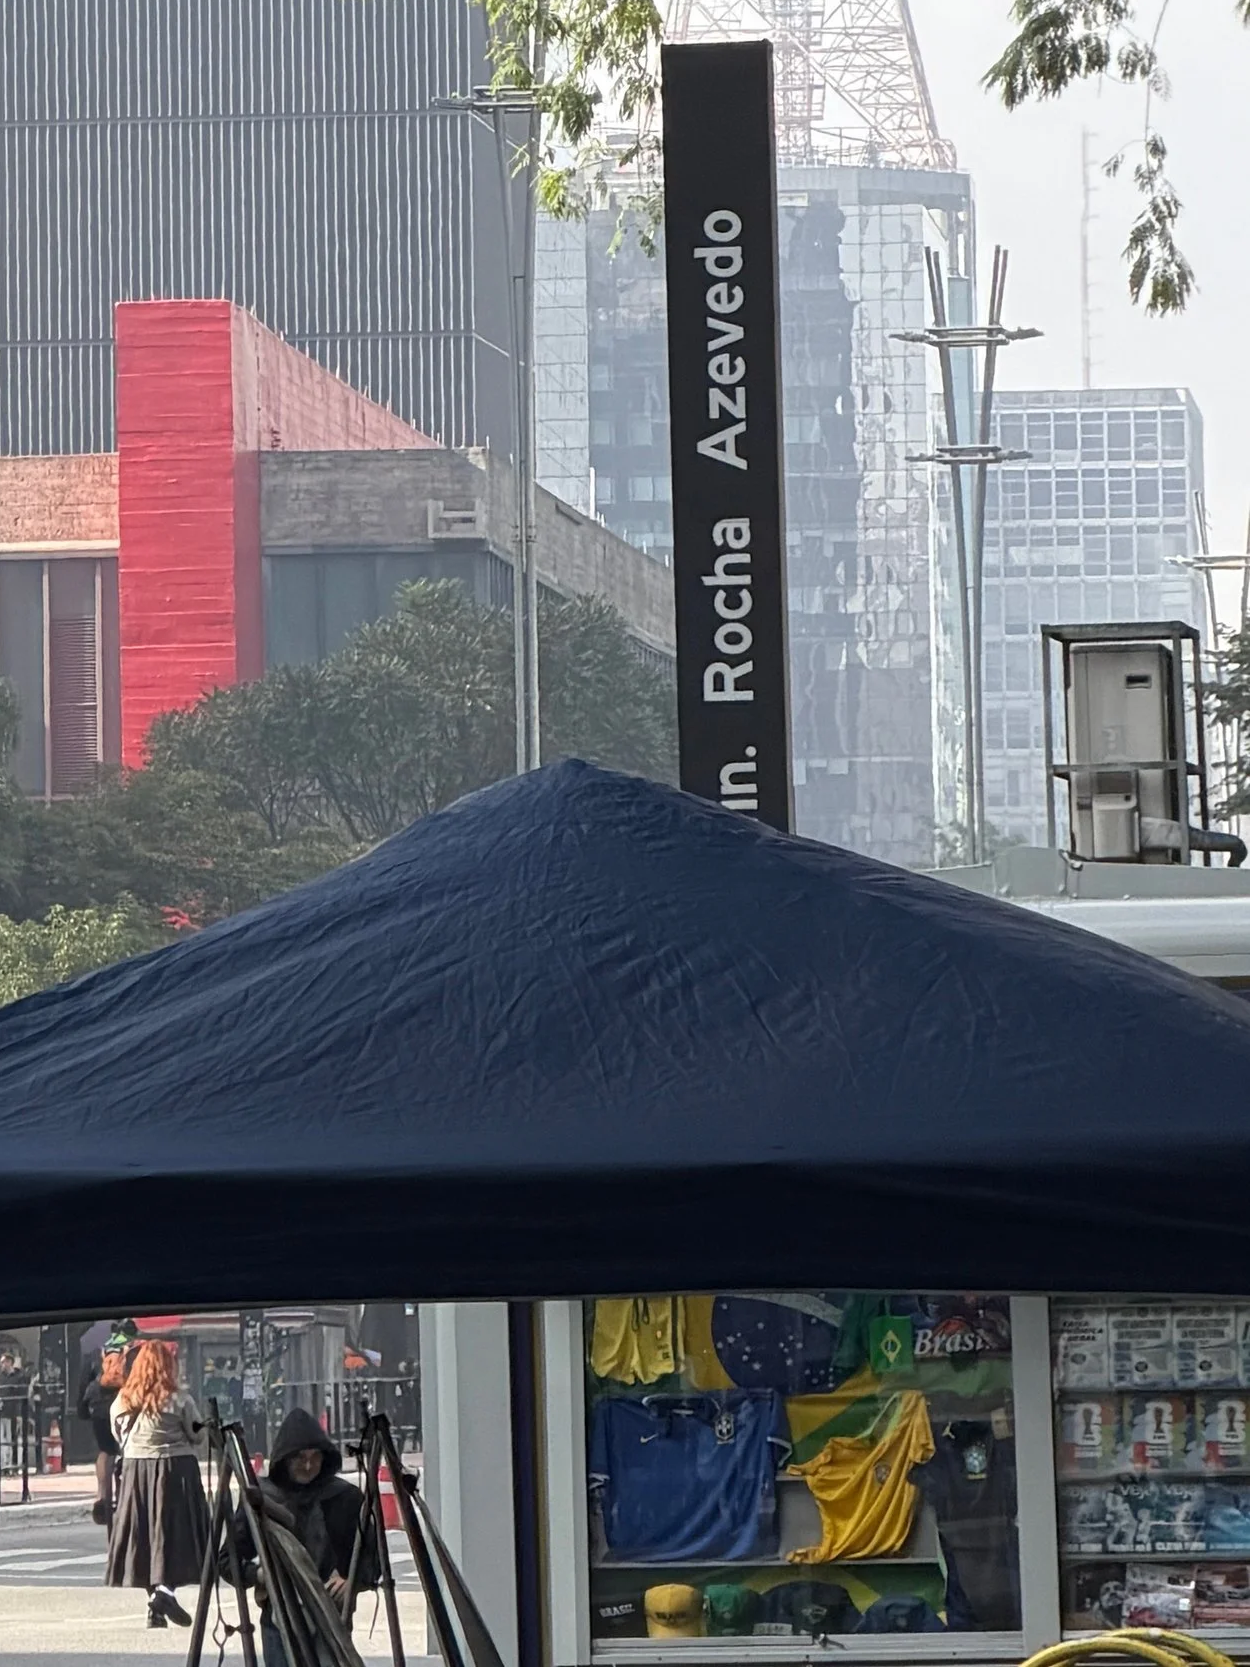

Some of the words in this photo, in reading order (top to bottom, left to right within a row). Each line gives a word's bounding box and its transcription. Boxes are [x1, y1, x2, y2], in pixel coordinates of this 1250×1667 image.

[693, 209, 748, 470] Azevedo
[701, 518, 754, 702] Rocha
[719, 745, 758, 810] in.
